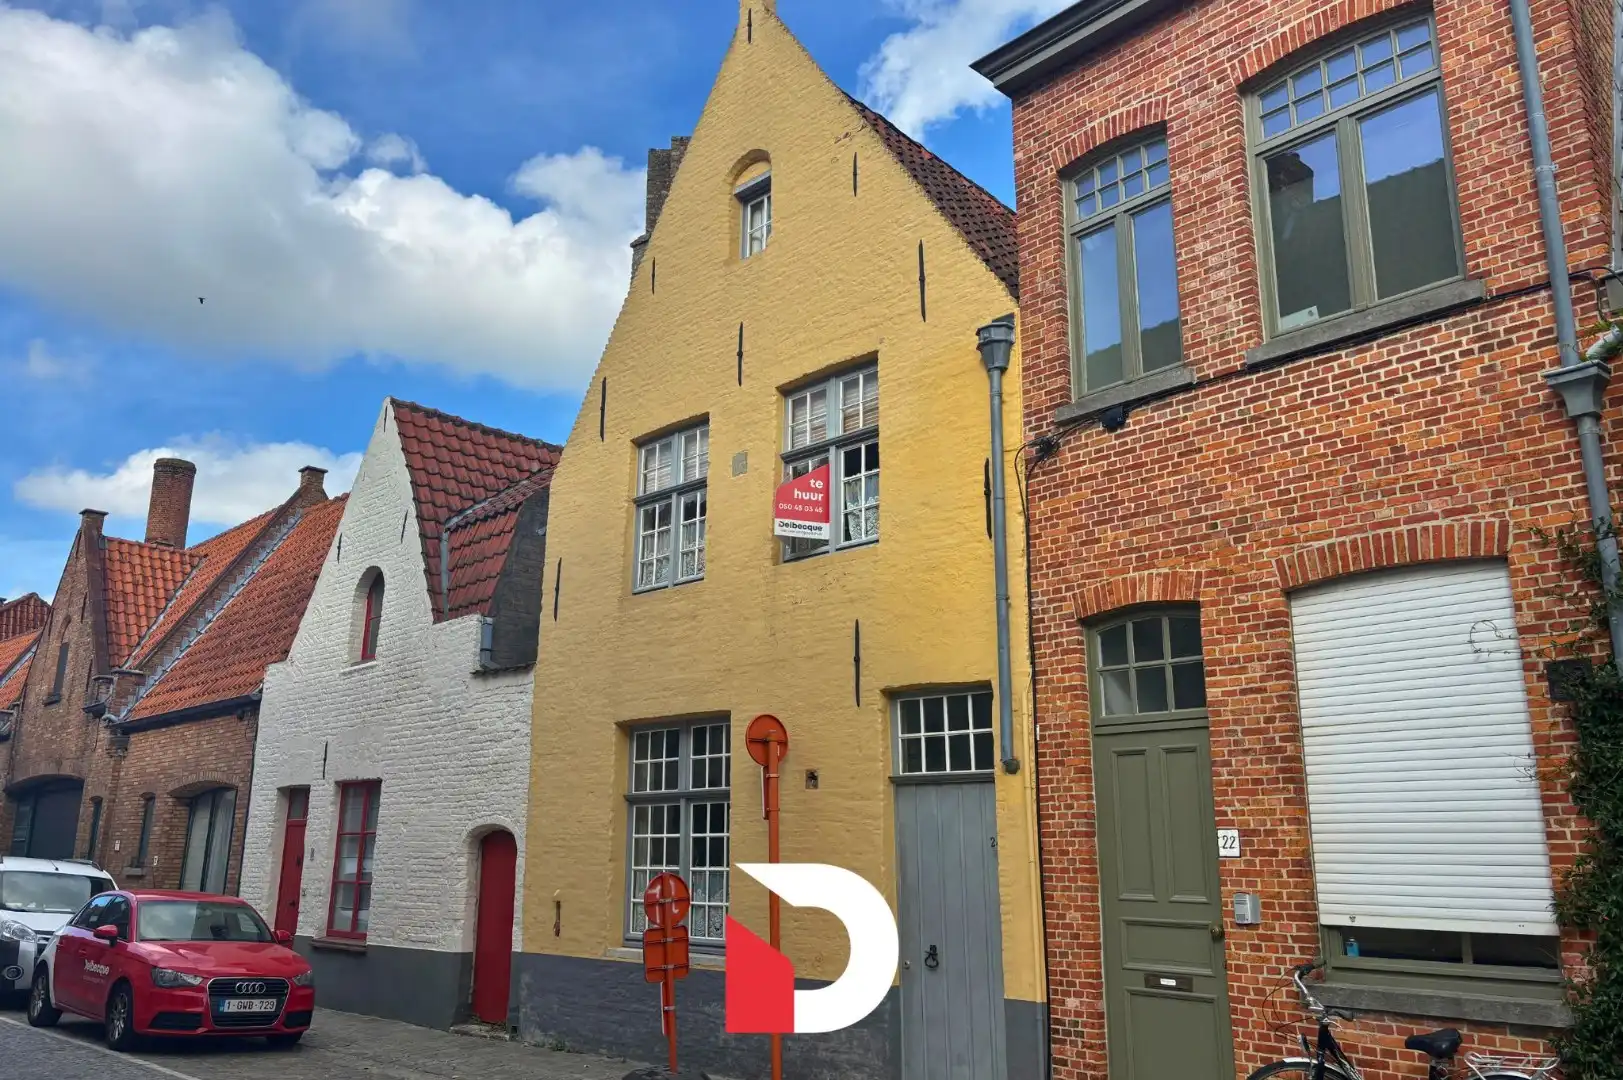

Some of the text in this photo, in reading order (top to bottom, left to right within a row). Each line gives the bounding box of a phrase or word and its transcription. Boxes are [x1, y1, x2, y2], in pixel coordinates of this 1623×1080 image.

[809, 478, 824, 489] te
[794, 488, 824, 501] huur
[794, 504, 803, 512] 45
[804, 505, 813, 513] 03
[814, 506, 823, 514] 45
[778, 521, 823, 532] Delbecque
[1222, 835, 1236, 849] 22
[227, 1000, 275, 1010] 1-GWB-729
